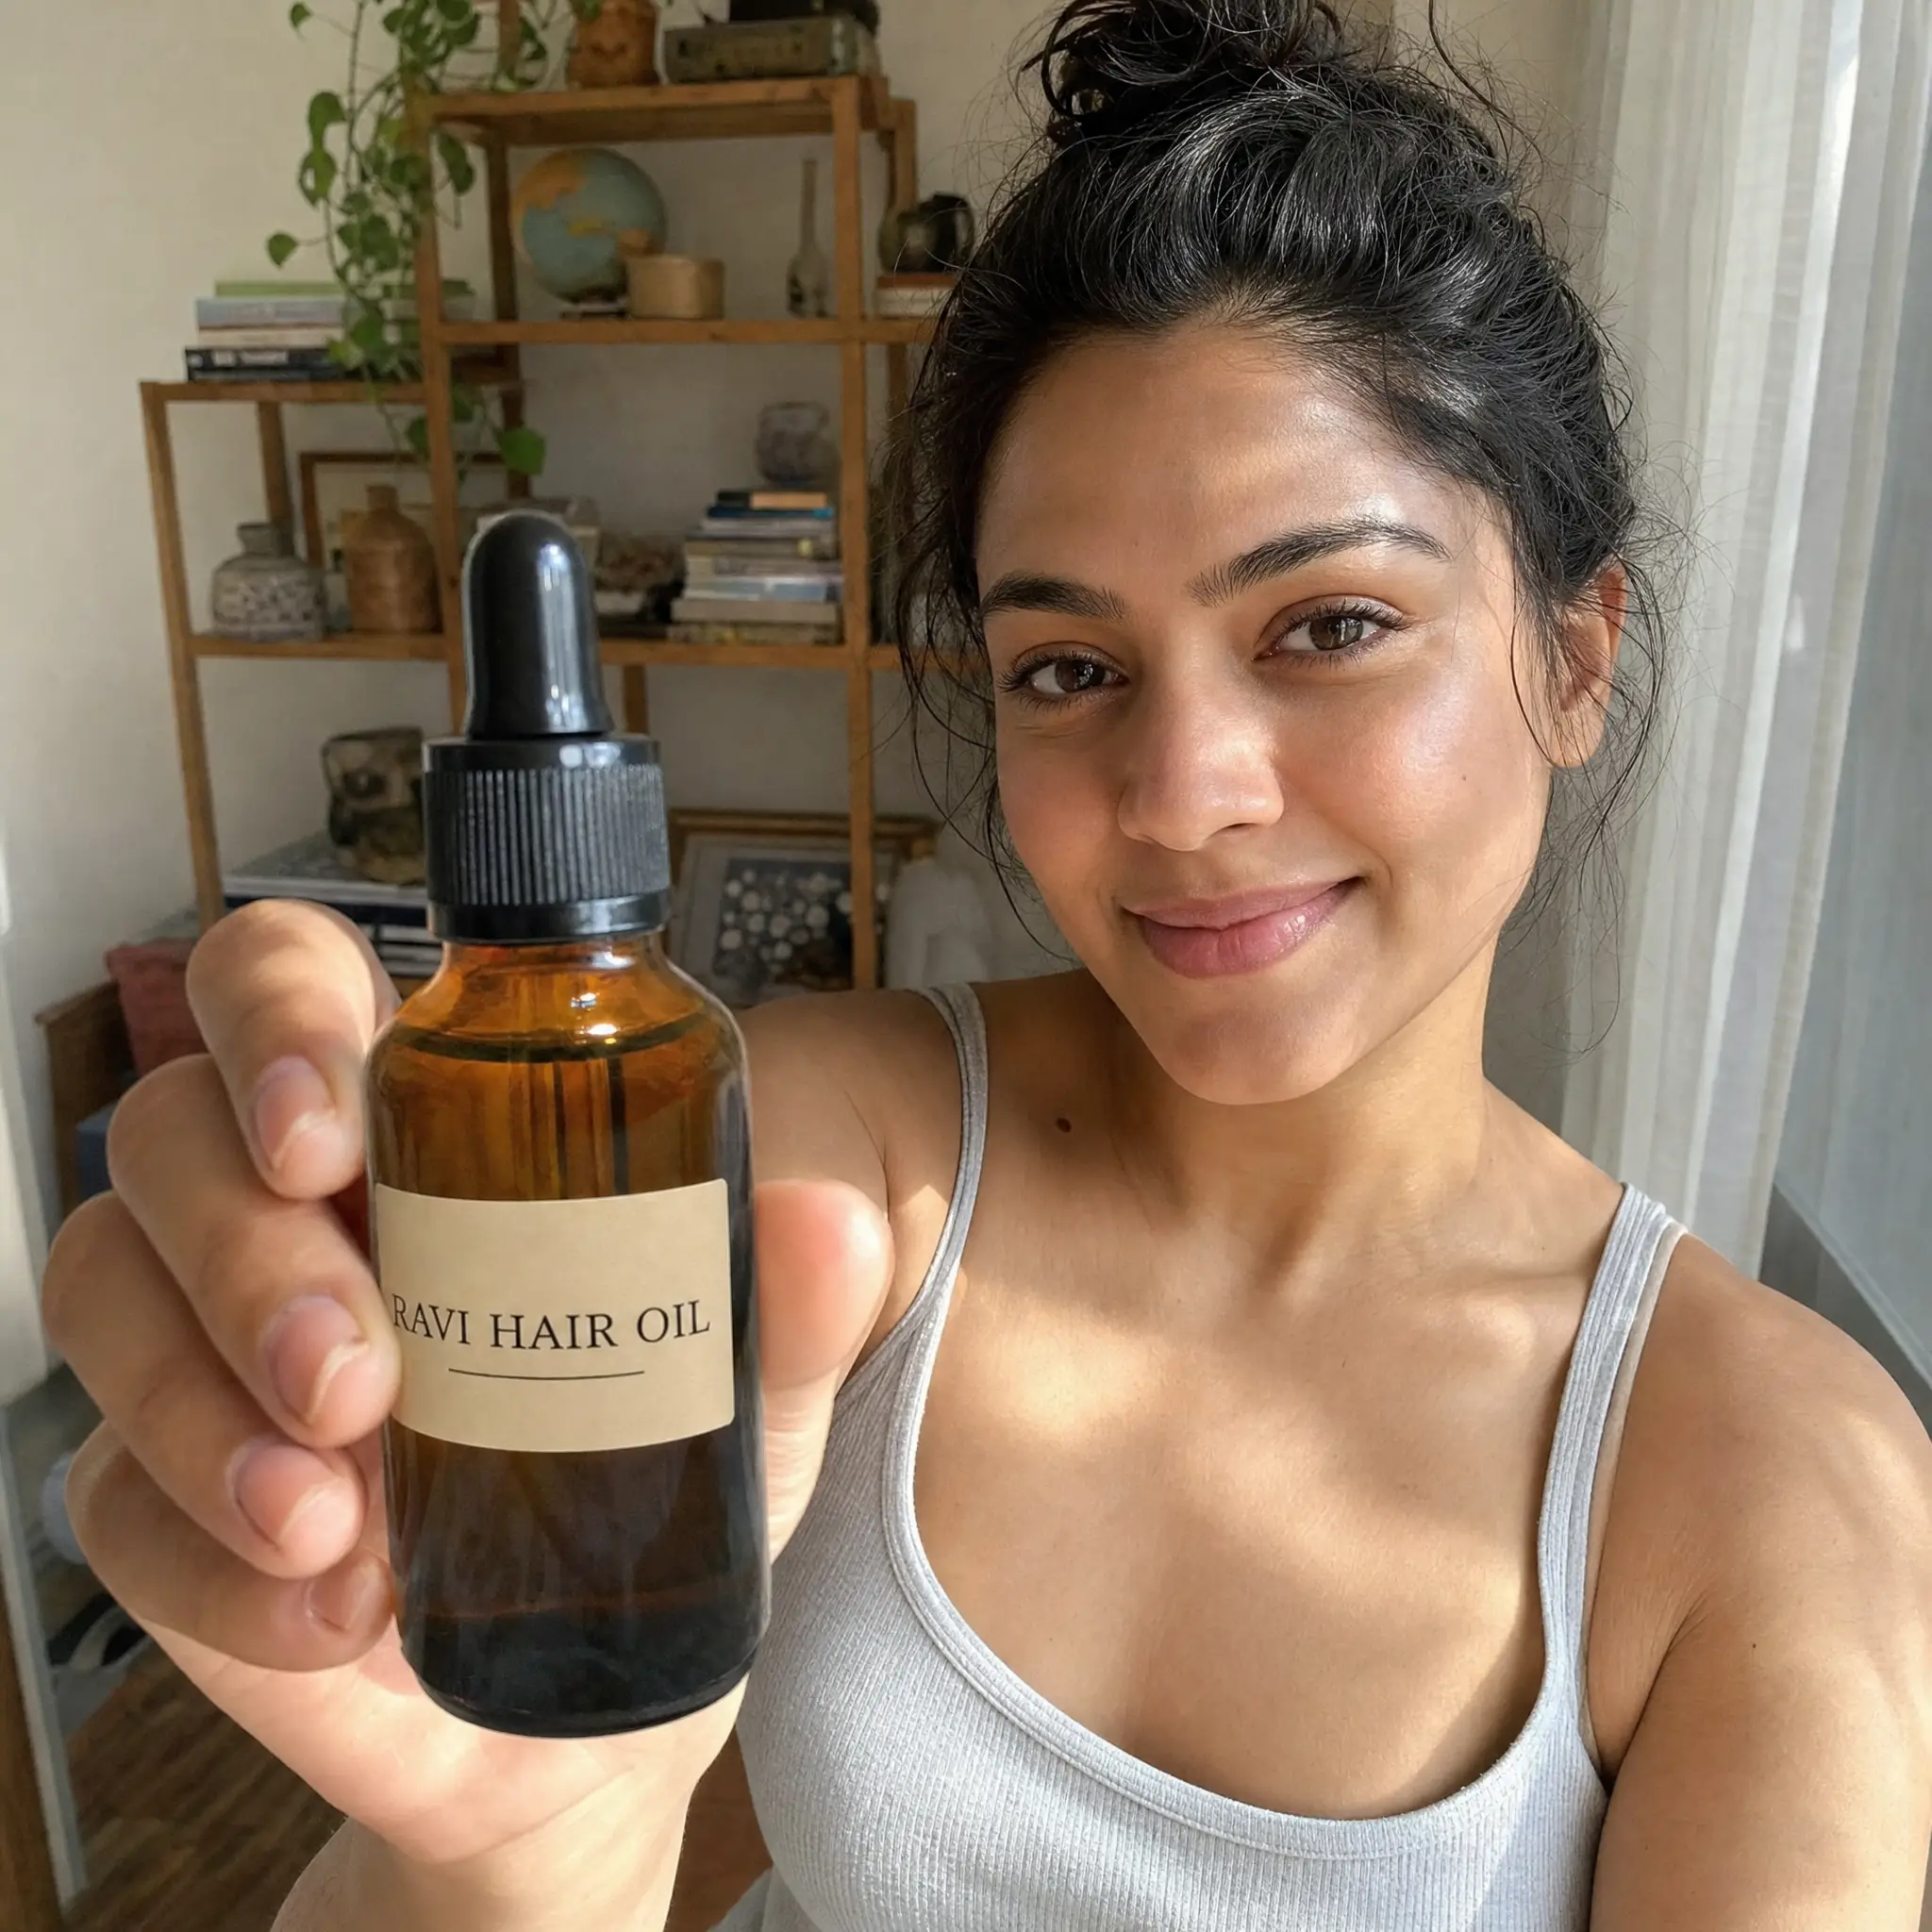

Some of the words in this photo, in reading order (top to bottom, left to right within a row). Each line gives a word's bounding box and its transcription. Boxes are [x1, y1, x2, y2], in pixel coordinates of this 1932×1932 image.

[391, 1293, 471, 1345] RAVI
[489, 1312, 619, 1351] HAIR
[636, 1299, 711, 1343] OIL
